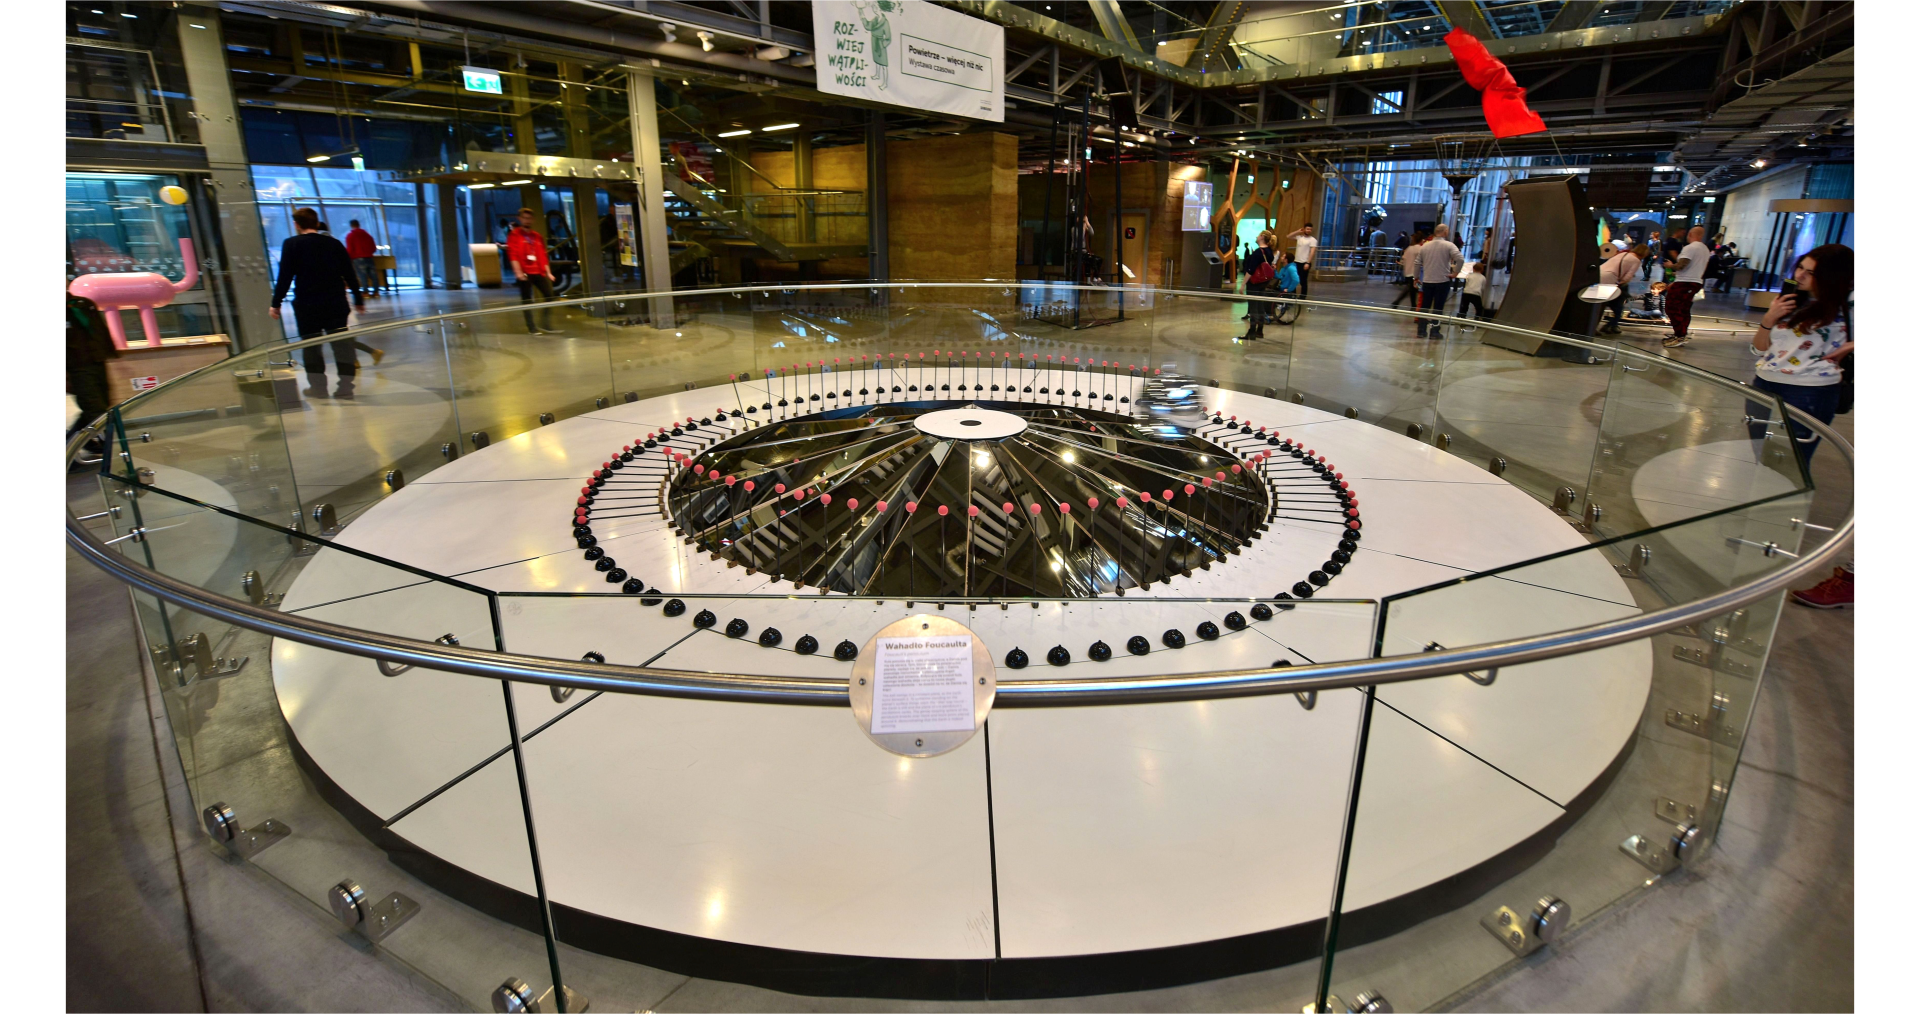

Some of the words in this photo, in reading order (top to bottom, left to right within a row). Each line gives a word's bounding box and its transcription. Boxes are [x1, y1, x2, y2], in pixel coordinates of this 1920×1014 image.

[834, 21, 858, 35] ROZ-
[837, 38, 864, 53] WIEJ
[828, 54, 868, 71] WĄTPLI-
[908, 44, 940, 60] Powietrze
[946, 55, 965, 68] więcej
[966, 60, 974, 69] niż
[975, 62, 983, 71] nic
[908, 57, 932, 68] Wystawa
[933, 64, 955, 75] czasowa
[835, 72, 866, 87] WOŚCI
[925, 640, 967, 649] Foucaulta
